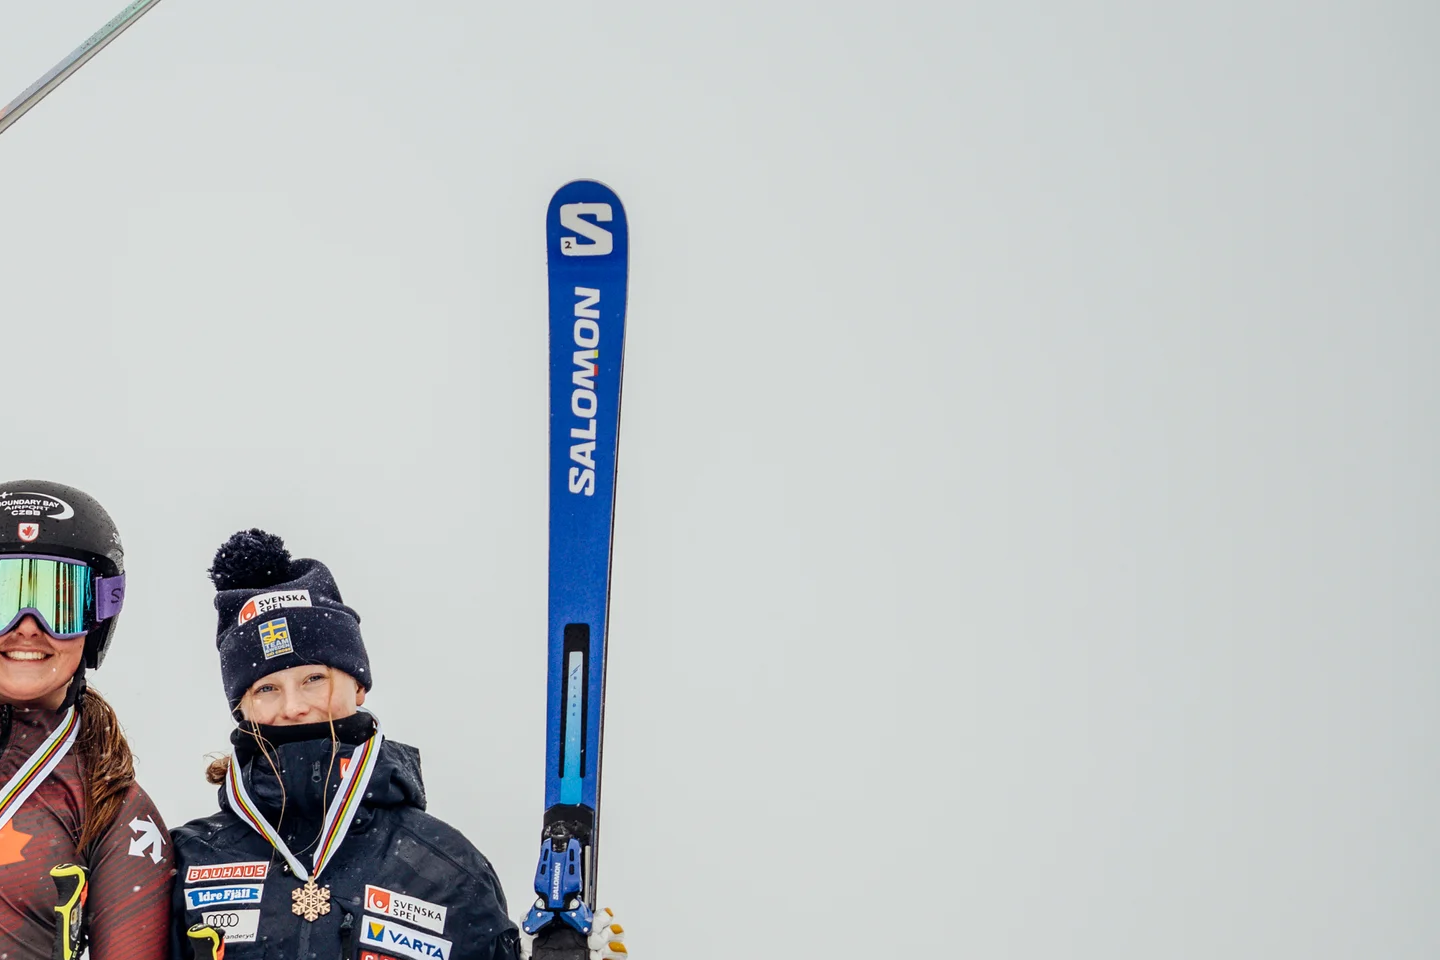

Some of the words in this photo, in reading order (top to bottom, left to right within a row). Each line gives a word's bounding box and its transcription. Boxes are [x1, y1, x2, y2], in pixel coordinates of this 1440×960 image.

[564, 241, 572, 250] 2
[568, 286, 601, 497] SALOMON
[42, 499, 60, 508] BAY
[258, 594, 307, 608] SVENSKA
[190, 866, 264, 880] BAUHAUS
[552, 862, 561, 901] SALOMON
[198, 891, 223, 902] Idre
[223, 888, 251, 901] Fjäll
[393, 899, 442, 921] SVENSKA
[393, 908, 418, 922] SPEL
[388, 929, 445, 960] VARTA
